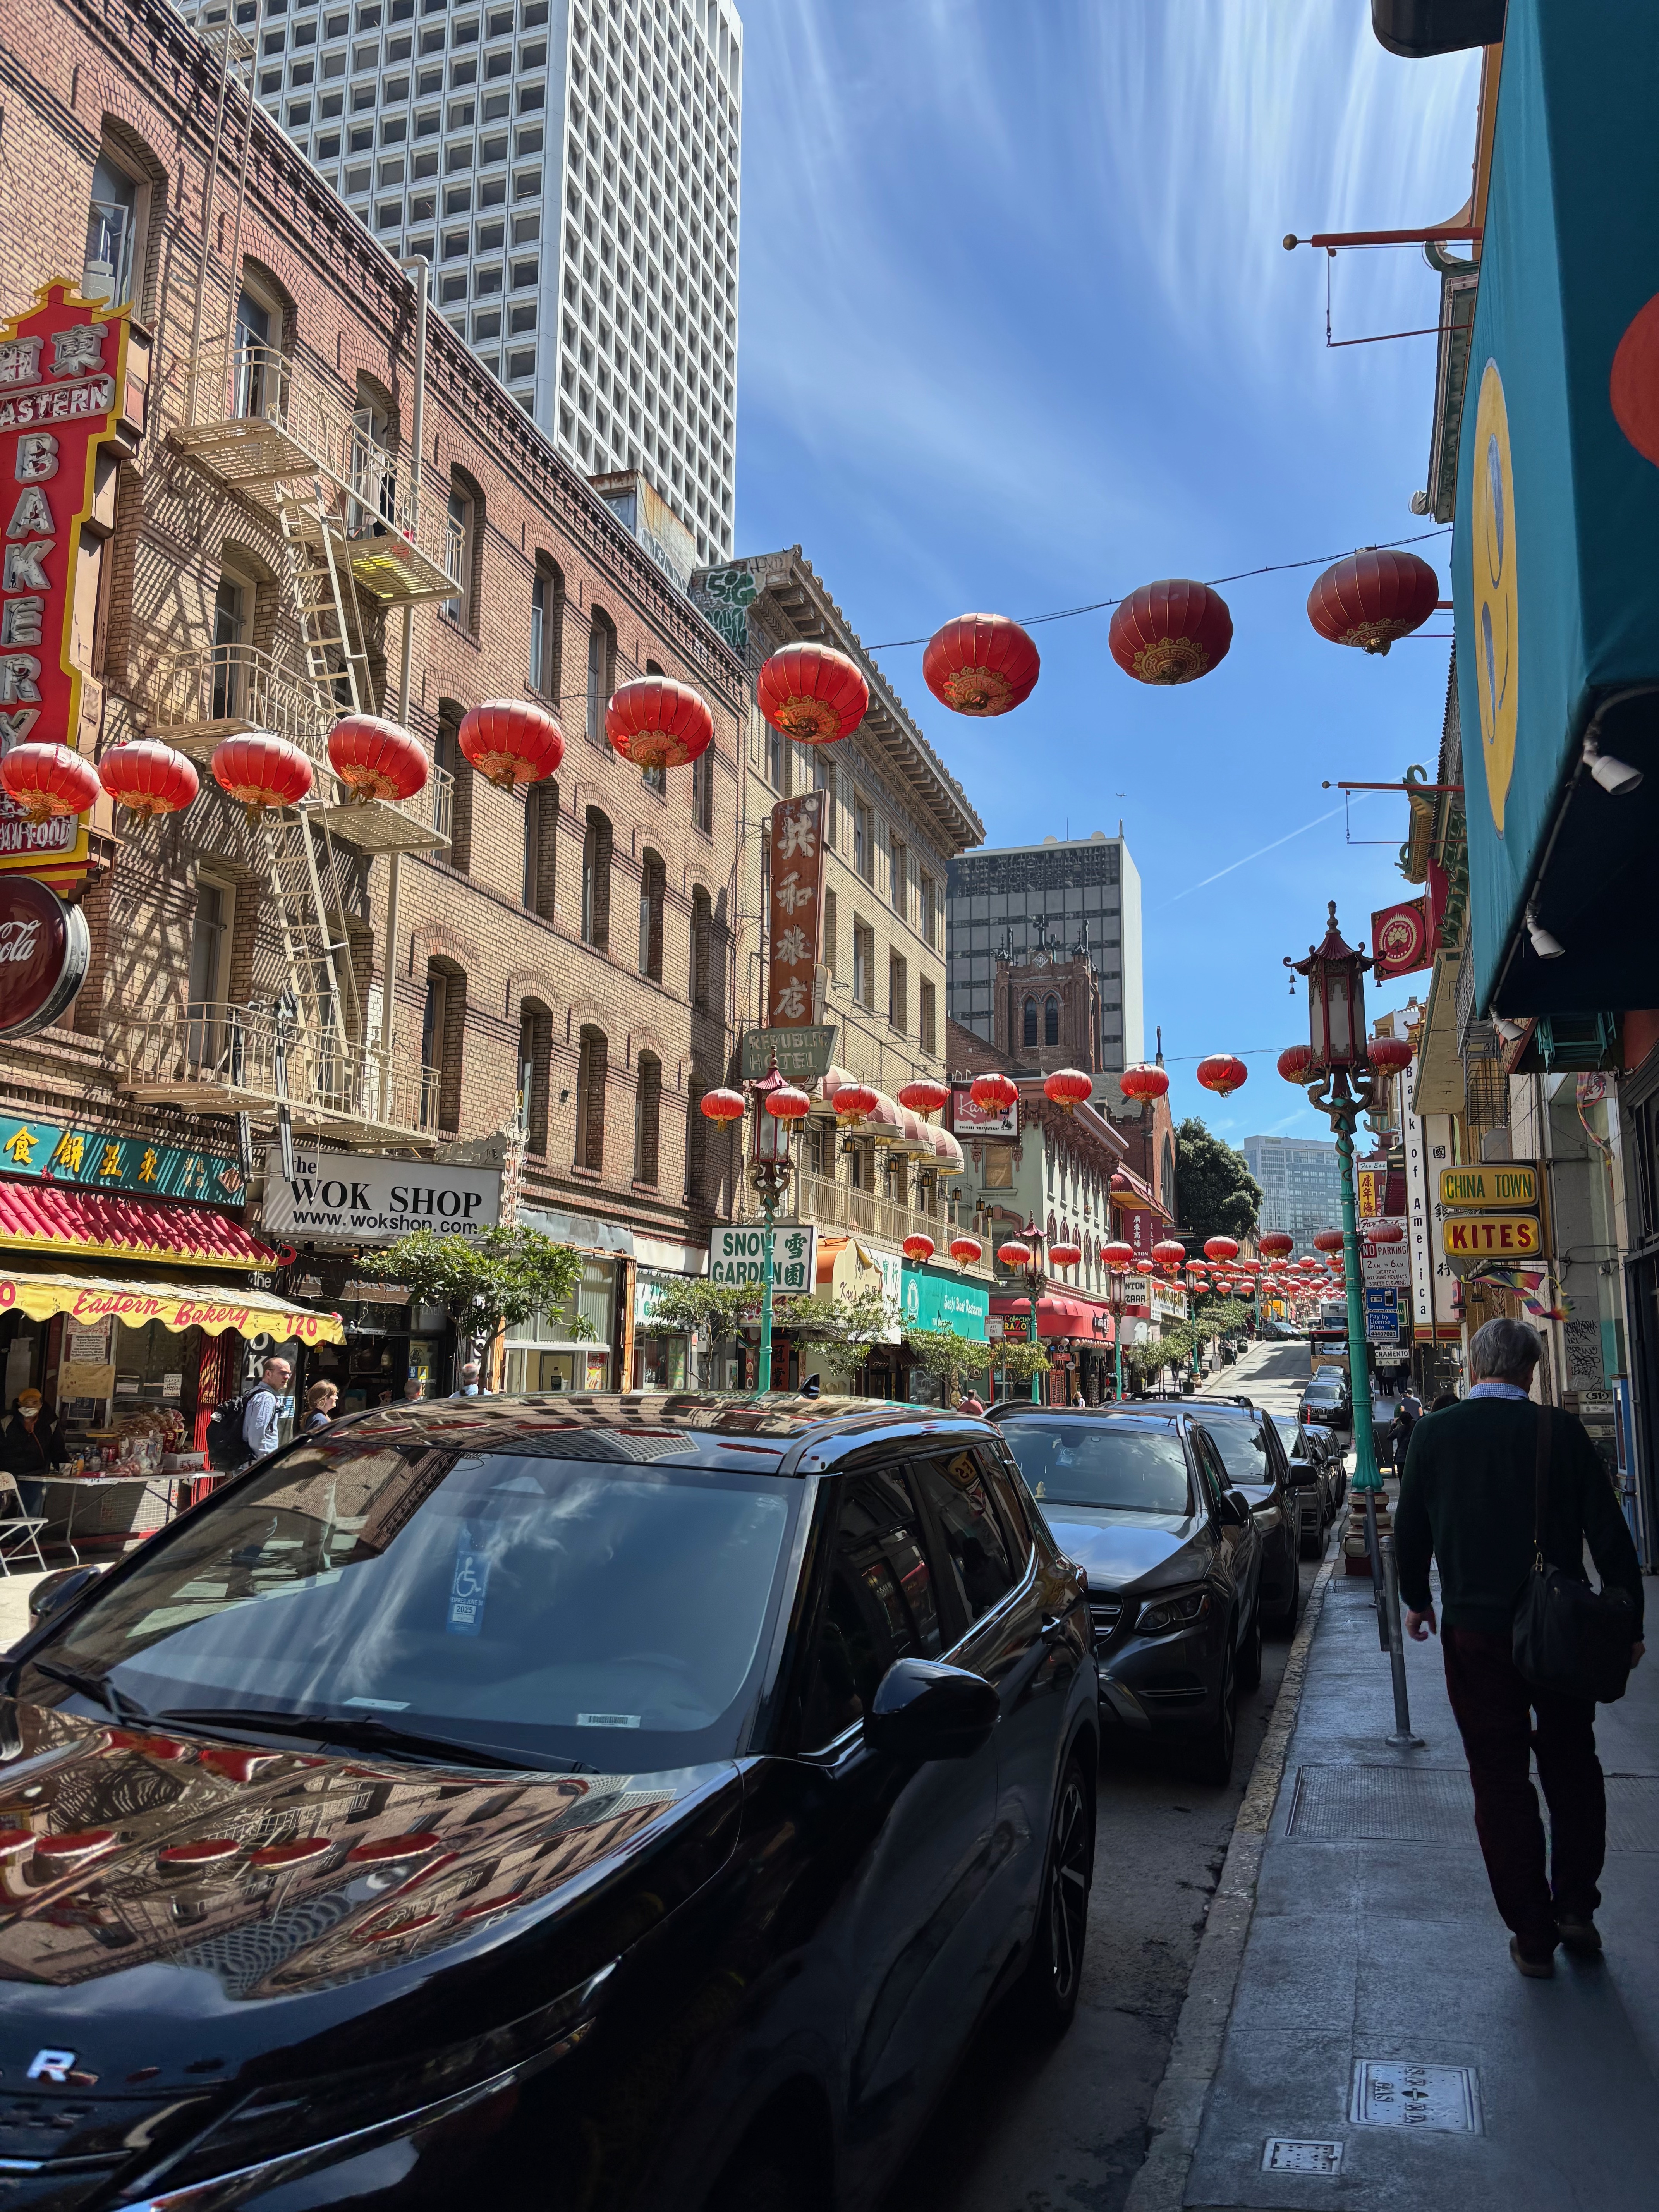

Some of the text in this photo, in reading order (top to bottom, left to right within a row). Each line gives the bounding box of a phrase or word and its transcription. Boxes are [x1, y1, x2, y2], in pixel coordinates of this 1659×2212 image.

[0, 382, 109, 426] ASTERN
[749, 1032, 828, 1050] REPUBLIC
[750, 1052, 817, 1072] HOTEL
[291, 1178, 482, 1218] WOK SHOP
[1446, 1174, 1532, 1199] CHINA TOWN
[293, 1210, 478, 1235] www.wokshop.com
[1453, 1223, 1532, 1250] KITES
[784, 1232, 808, 1288] 雪園
[1362, 1244, 1407, 1256] NO PARKING
[1126, 1295, 1146, 1303] ZAAR
[72, 1289, 318, 1337] Eastern Bakery 720
[1374, 2081, 1394, 2102] GAS
